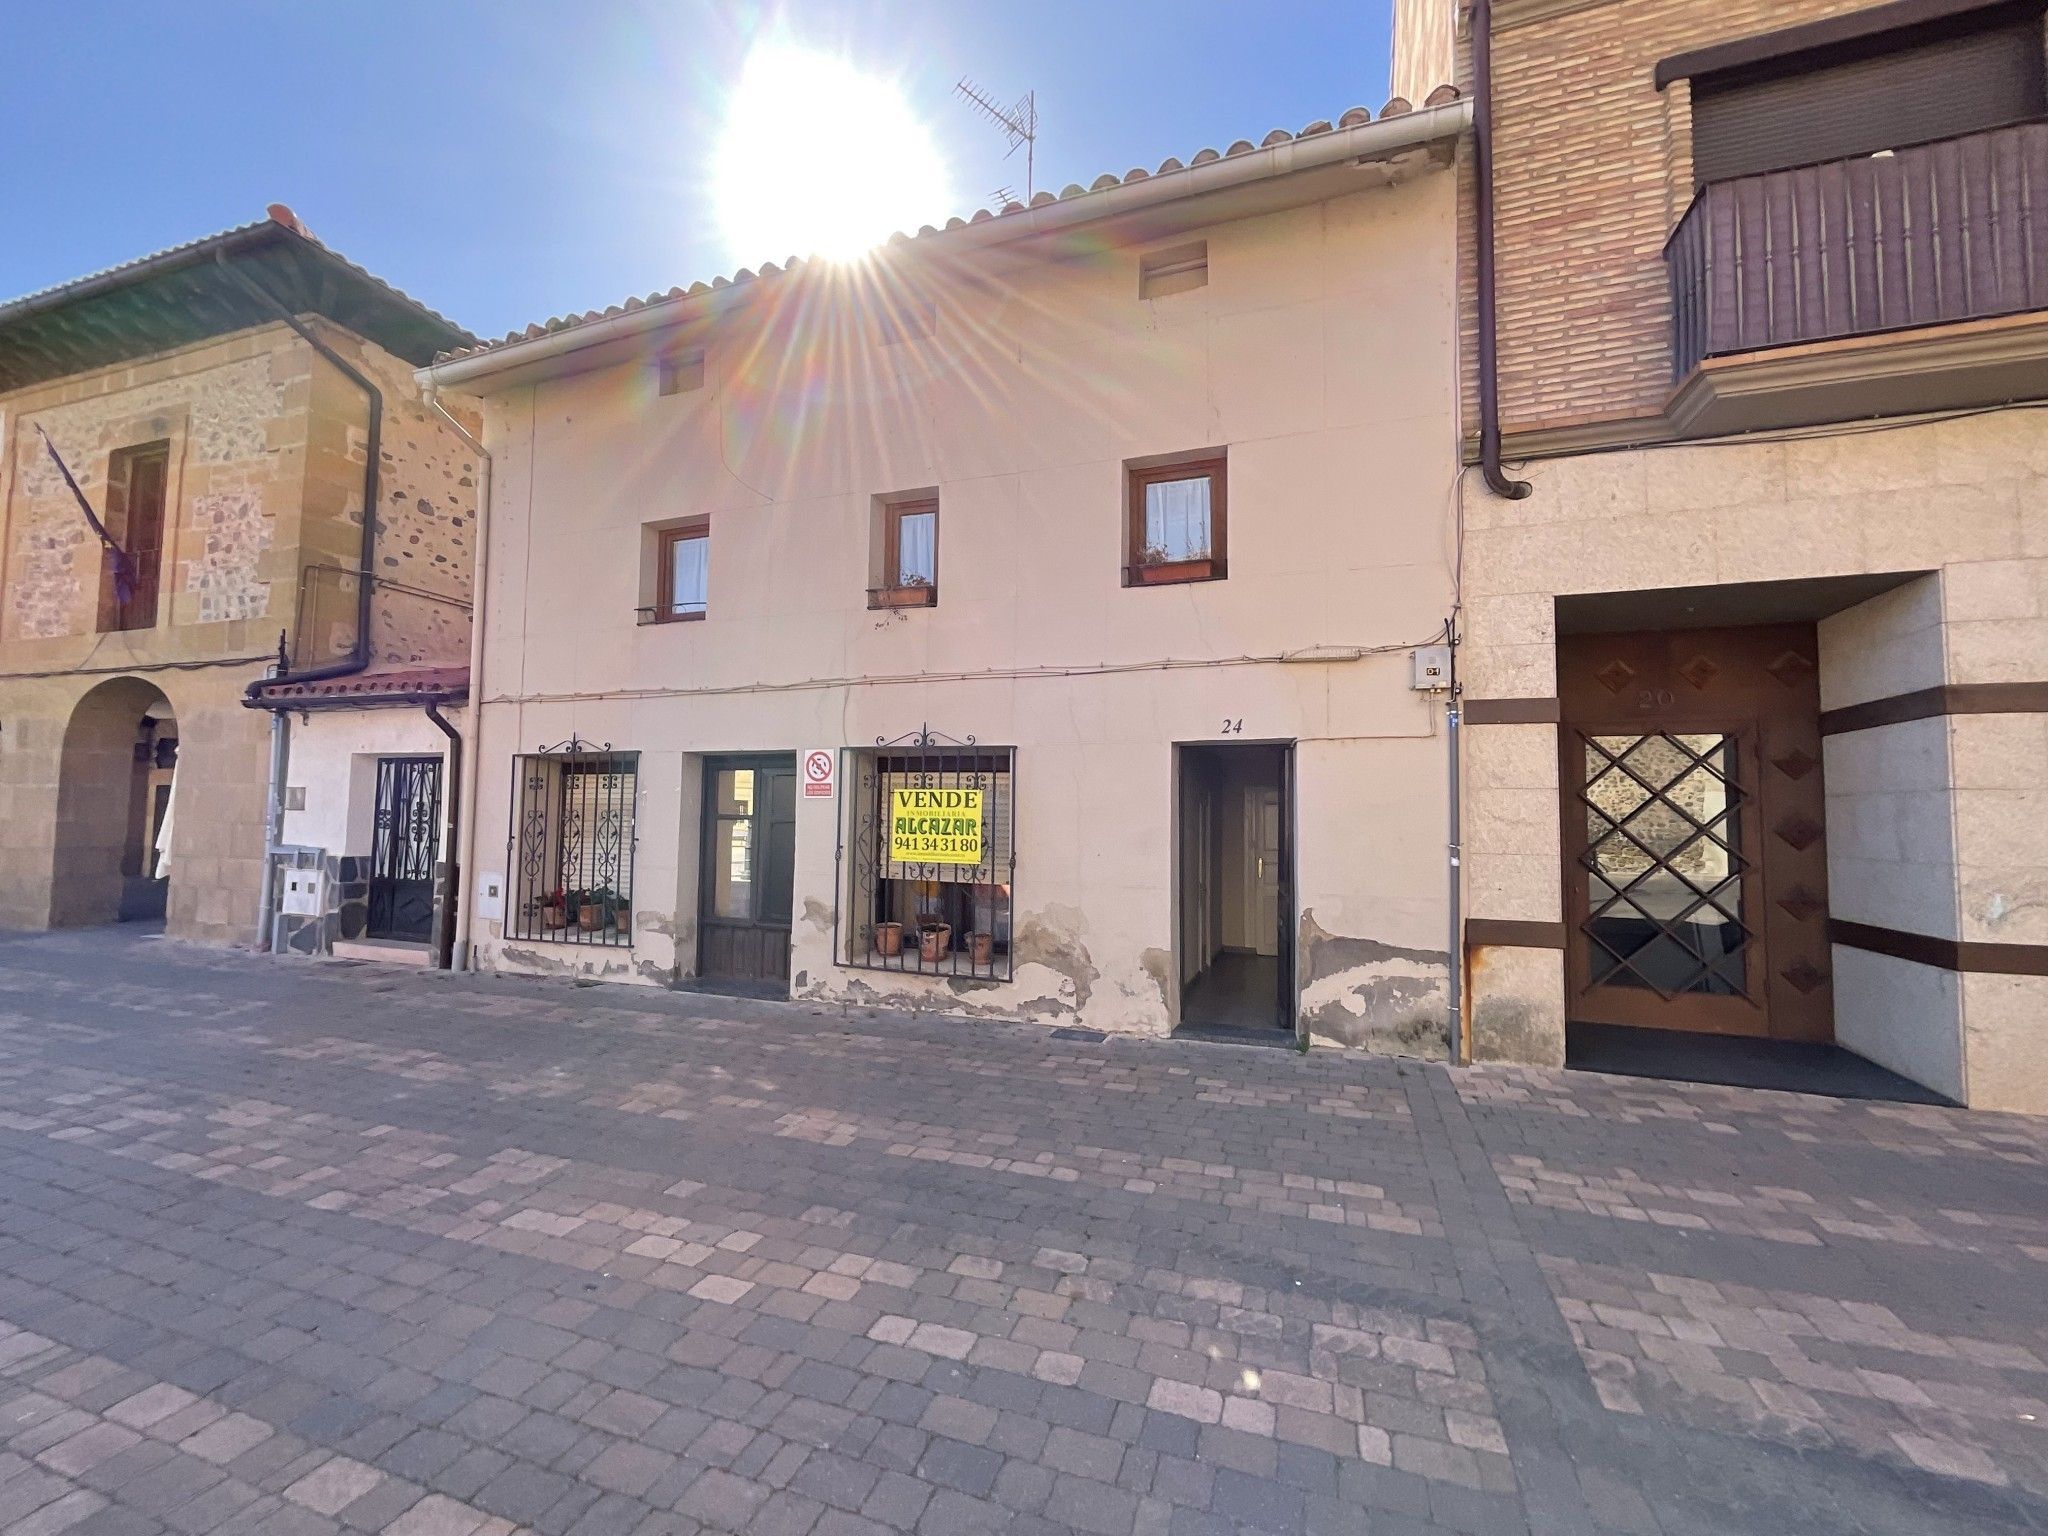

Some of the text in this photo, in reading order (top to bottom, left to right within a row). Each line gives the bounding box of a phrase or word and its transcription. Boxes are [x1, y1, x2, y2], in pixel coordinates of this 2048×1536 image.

[1638, 689, 1674, 708] 20
[1221, 718, 1243, 734] 24
[899, 791, 978, 808] VENDE
[895, 816, 978, 836] ALCAZAR
